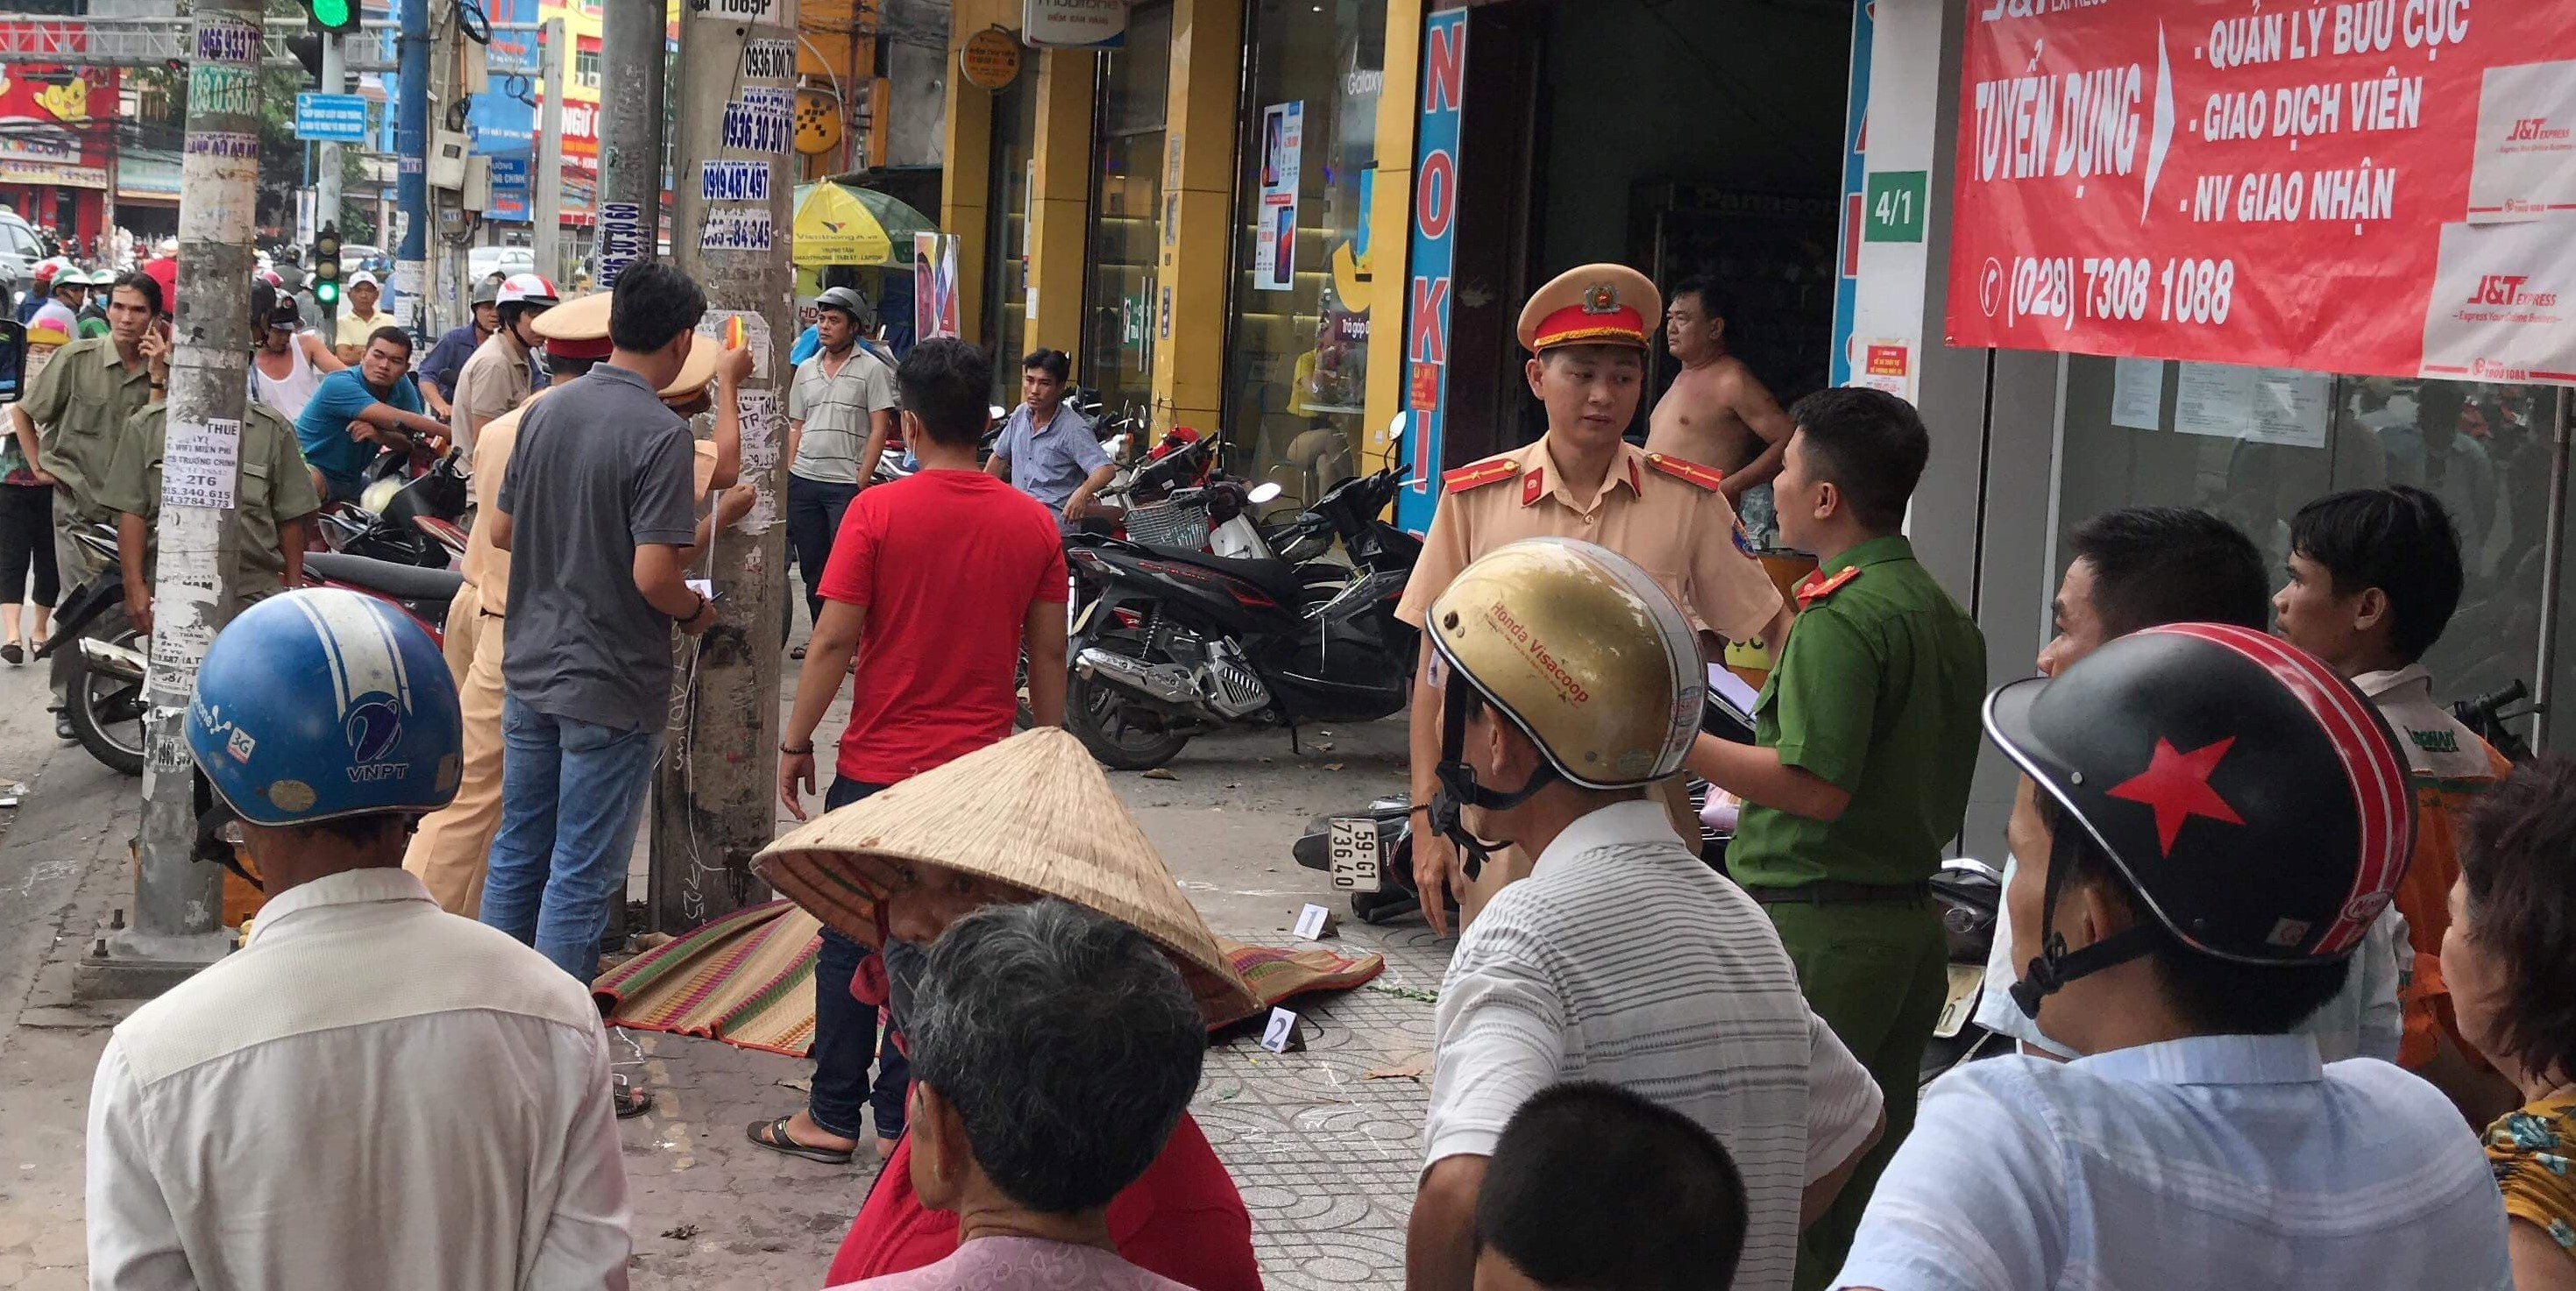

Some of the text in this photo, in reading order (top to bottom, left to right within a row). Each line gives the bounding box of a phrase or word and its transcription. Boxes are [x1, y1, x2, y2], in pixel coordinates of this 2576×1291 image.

[2209, 0, 2282, 70] QUẢN
[2289, 0, 2327, 60] LÝ
[2402, 0, 2470, 61] CỤC
[1348, 71, 1383, 95] Galaxy
[1975, 39, 2140, 198] TUYỂN DỤNG
[2203, 66, 2423, 151] GIAO DỊCH VIÊN
[2506, 118, 2570, 141] J&T EXPRESS
[703, 168, 769, 200] 0919.487.497
[2194, 156, 2396, 236] NV GIAO NHẬN
[1875, 188, 1912, 226] 4/1
[1409, 21, 1462, 543] NOKI
[2008, 257, 2234, 331] (028) 7308 1088
[2466, 275, 2557, 306] J&T EXPRESS
[1342, 317, 1352, 333] Trả
[1352, 318, 1366, 338] góp
[207, 422, 238, 436] THUÊ
[186, 475, 216, 486] 2T6
[1491, 602, 1528, 643] Honda
[1529, 639, 1588, 703] Visacoop
[232, 732, 251, 755] 3G
[346, 763, 409, 783] VNPT
[1332, 824, 1354, 887] 736.40
[1355, 831, 1376, 881] 59-G1
[1303, 911, 1317, 935] 1
[1266, 1017, 1287, 1047] 2
